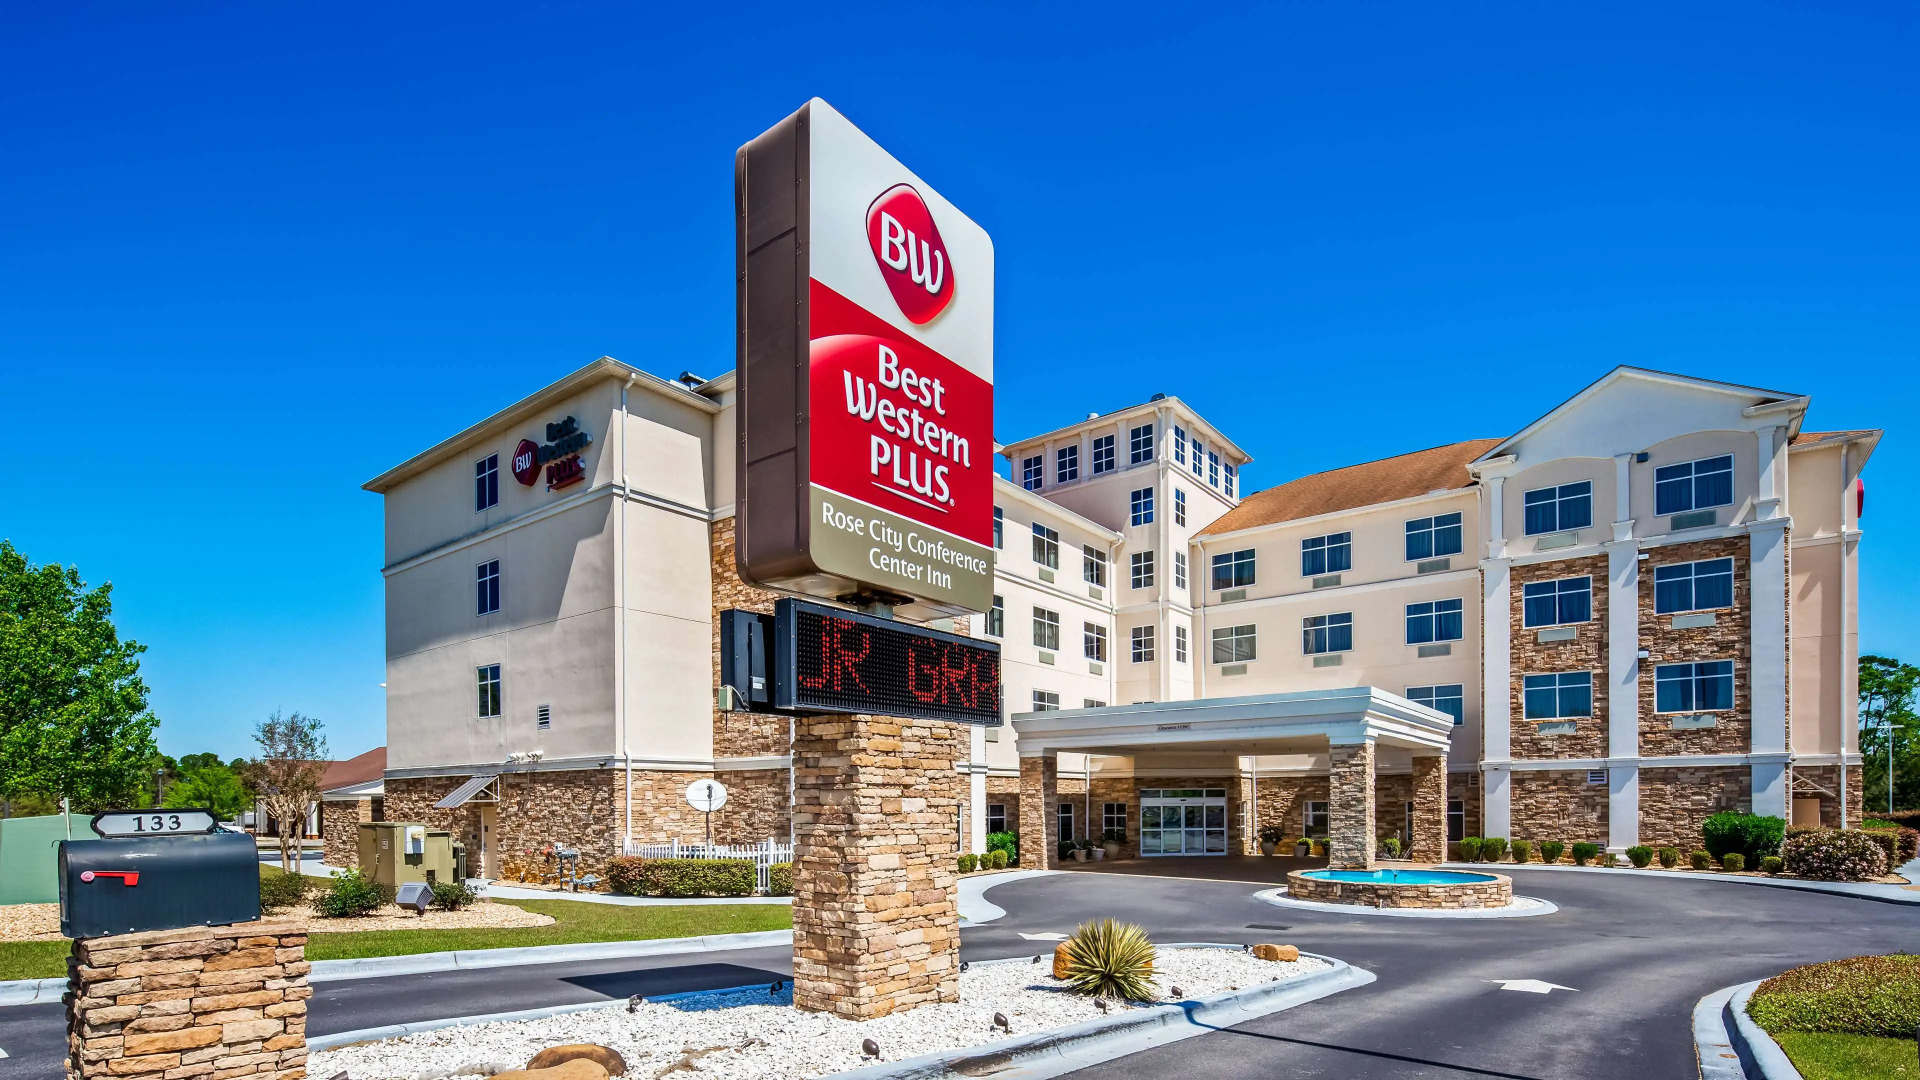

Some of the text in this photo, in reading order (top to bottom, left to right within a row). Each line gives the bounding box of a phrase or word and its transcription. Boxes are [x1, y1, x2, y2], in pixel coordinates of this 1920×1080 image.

[881, 211, 944, 294] BW
[878, 343, 946, 416] Best
[843, 369, 971, 468] Western
[515, 452, 532, 473] BW
[822, 501, 987, 576] Rose City Conference
[869, 547, 951, 590] Center Inn
[798, 615, 870, 695] JR
[132, 814, 182, 832] 133
